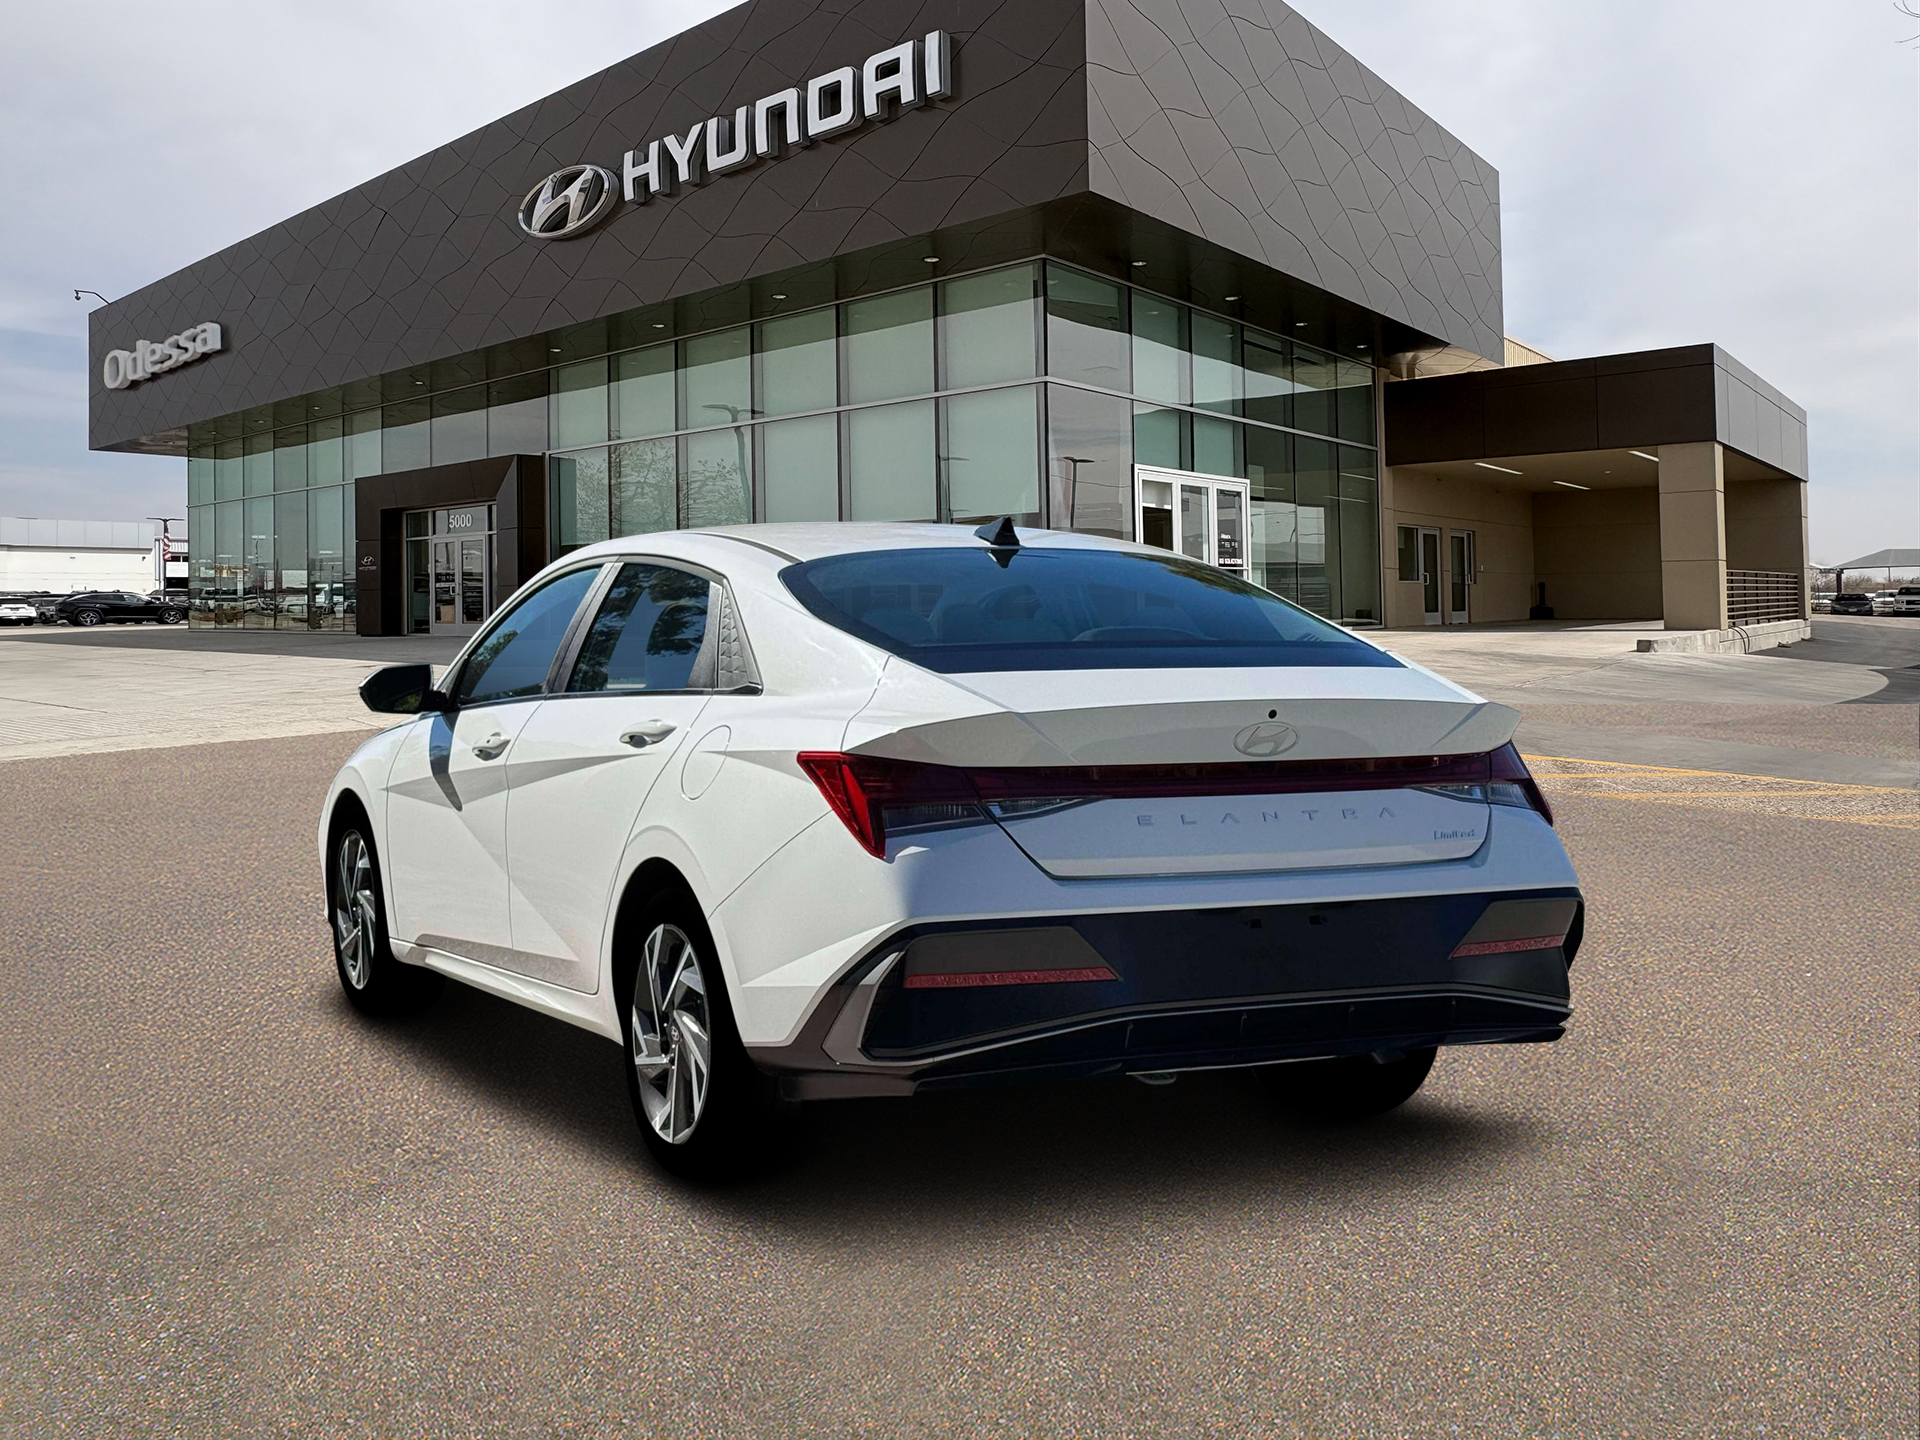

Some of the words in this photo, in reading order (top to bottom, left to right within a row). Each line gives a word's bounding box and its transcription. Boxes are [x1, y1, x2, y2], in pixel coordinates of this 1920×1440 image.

[622, 29, 951, 203] HYUNDAI
[103, 321, 222, 390] Odessa
[448, 513, 473, 529] 5000
[1136, 806, 1396, 827] ELANTRA
